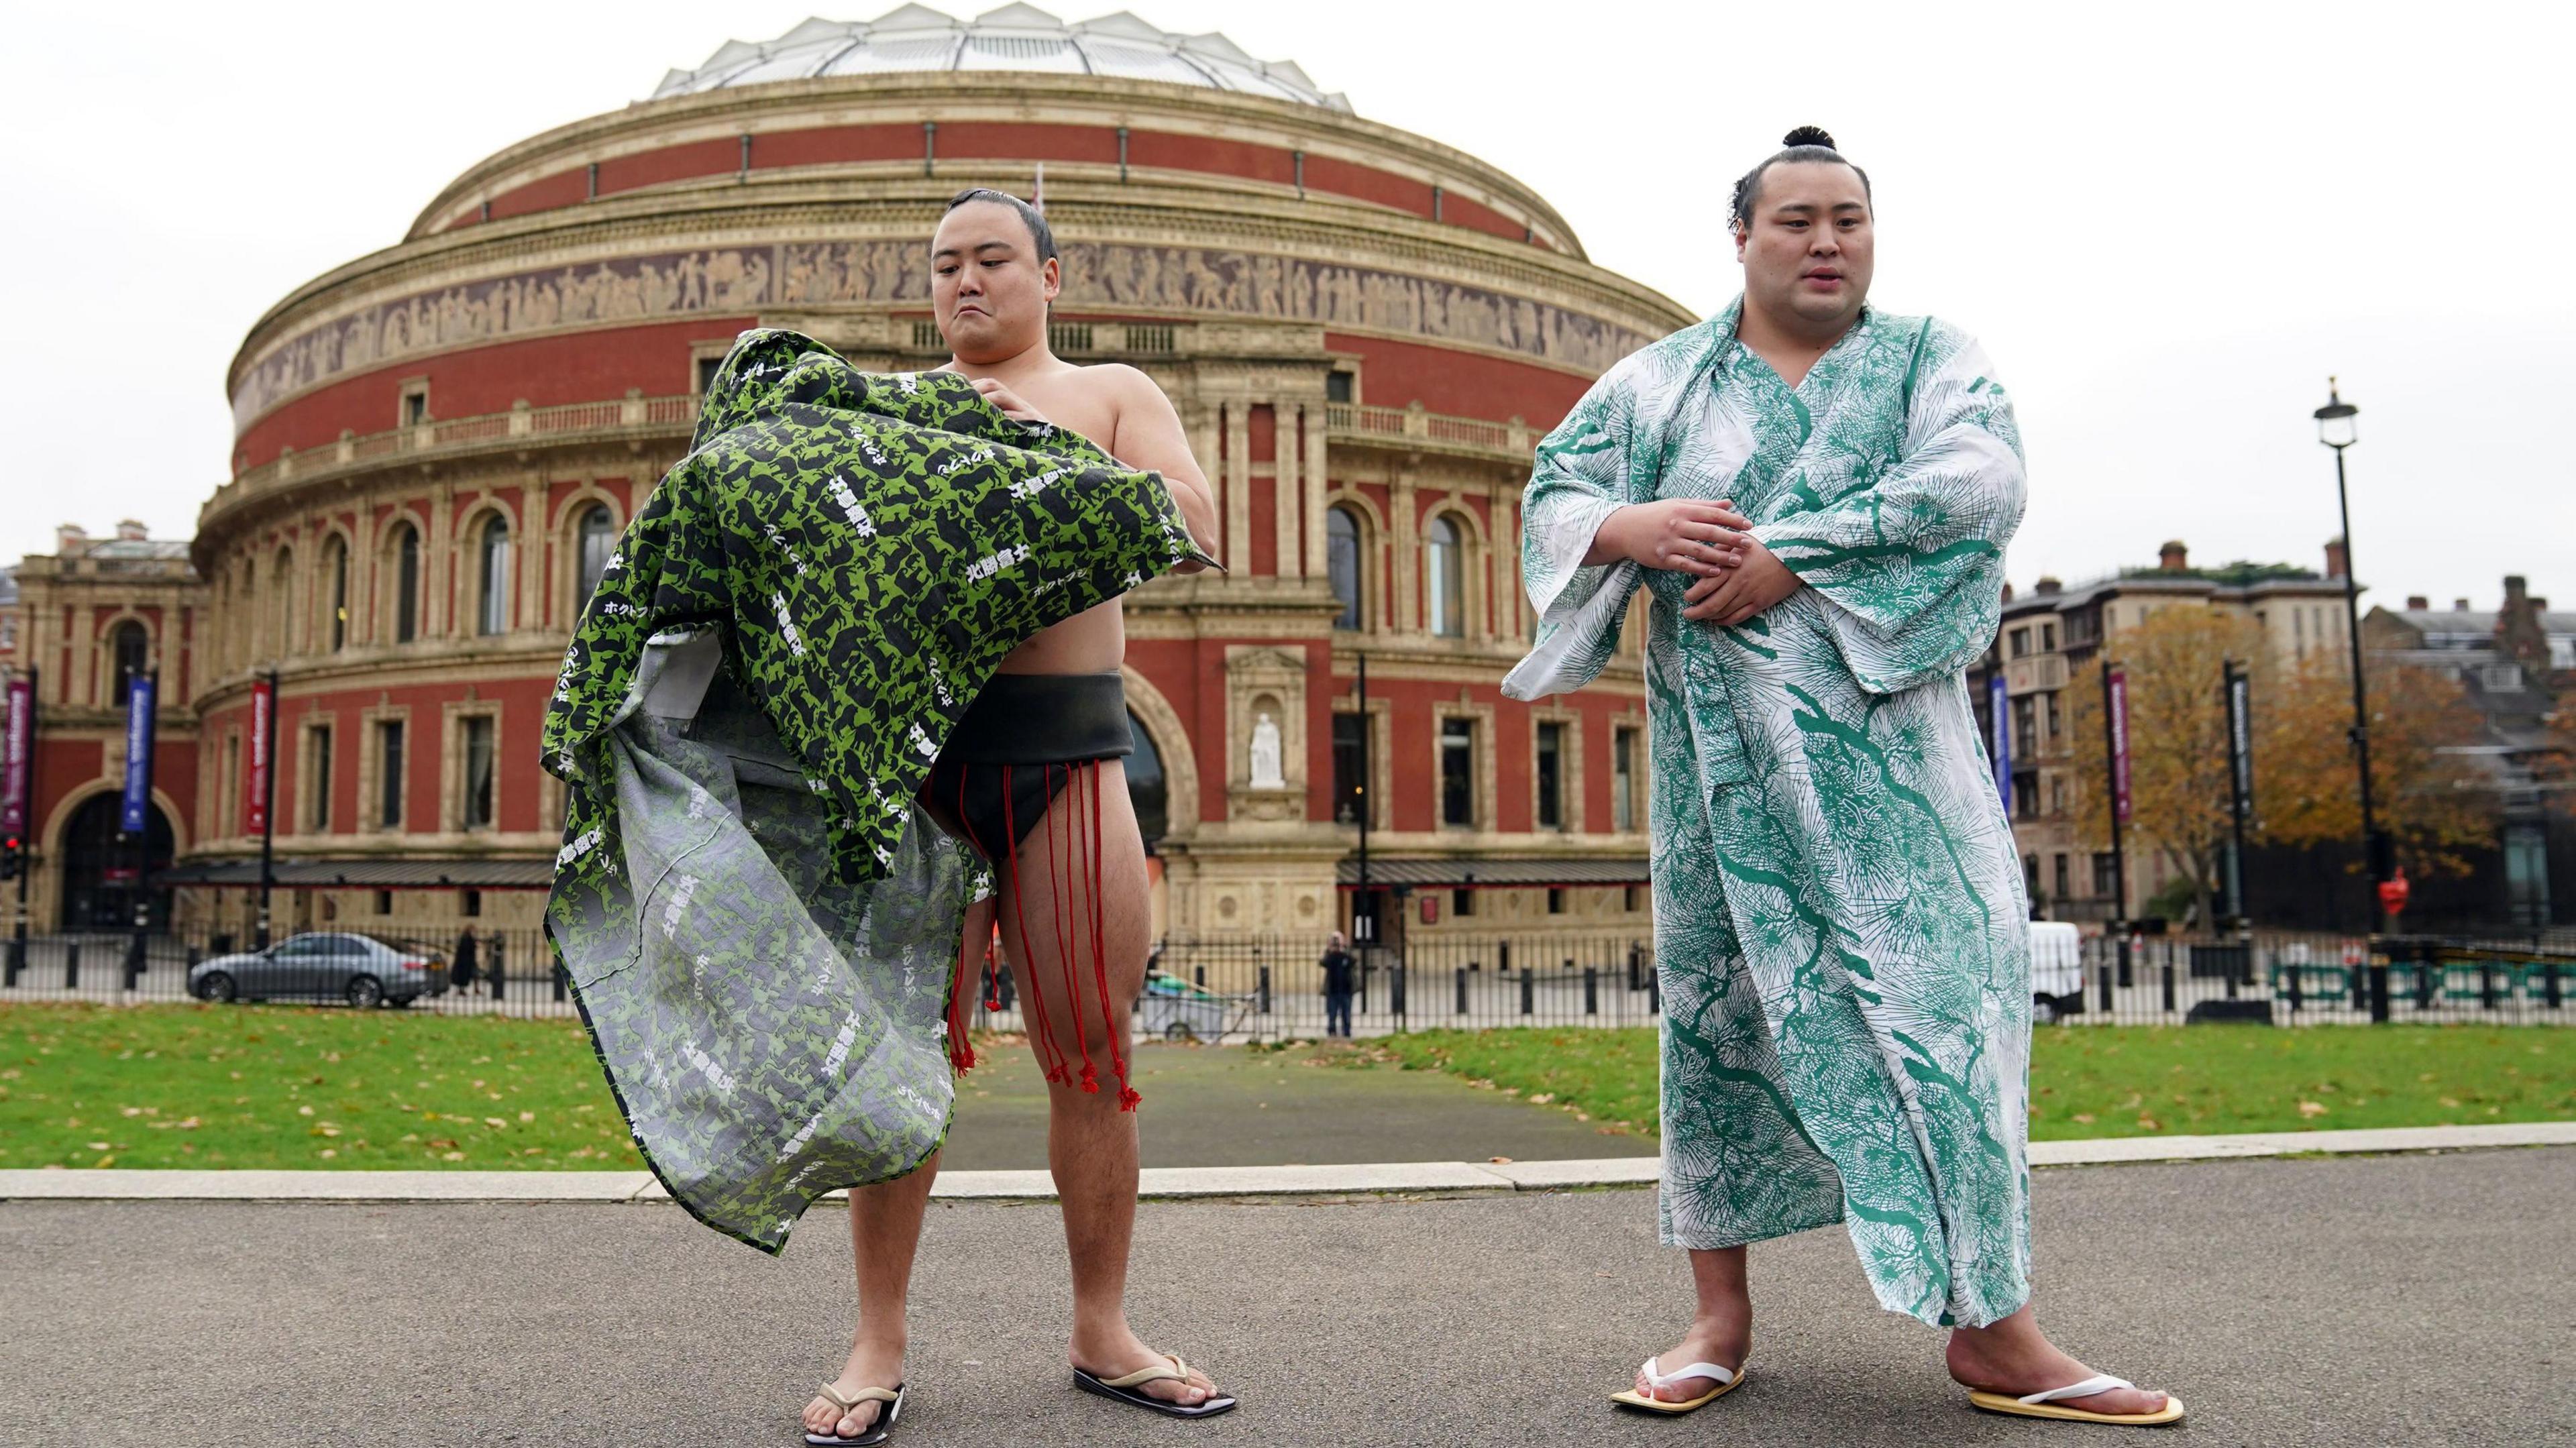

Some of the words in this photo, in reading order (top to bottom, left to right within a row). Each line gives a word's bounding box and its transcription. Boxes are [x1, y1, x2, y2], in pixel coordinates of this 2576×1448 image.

[848, 426, 886, 465] ホクトフジ
[938, 448, 996, 476] ホクトフジ
[763, 524, 808, 576] ホクトフジ
[965, 543, 1031, 583] 北勝富士
[1034, 568, 1088, 598] ホクトフジ
[604, 601, 651, 618] ホクトフ
[928, 657, 953, 708] ホクトフジ
[867, 777, 911, 824] ホクトフジ
